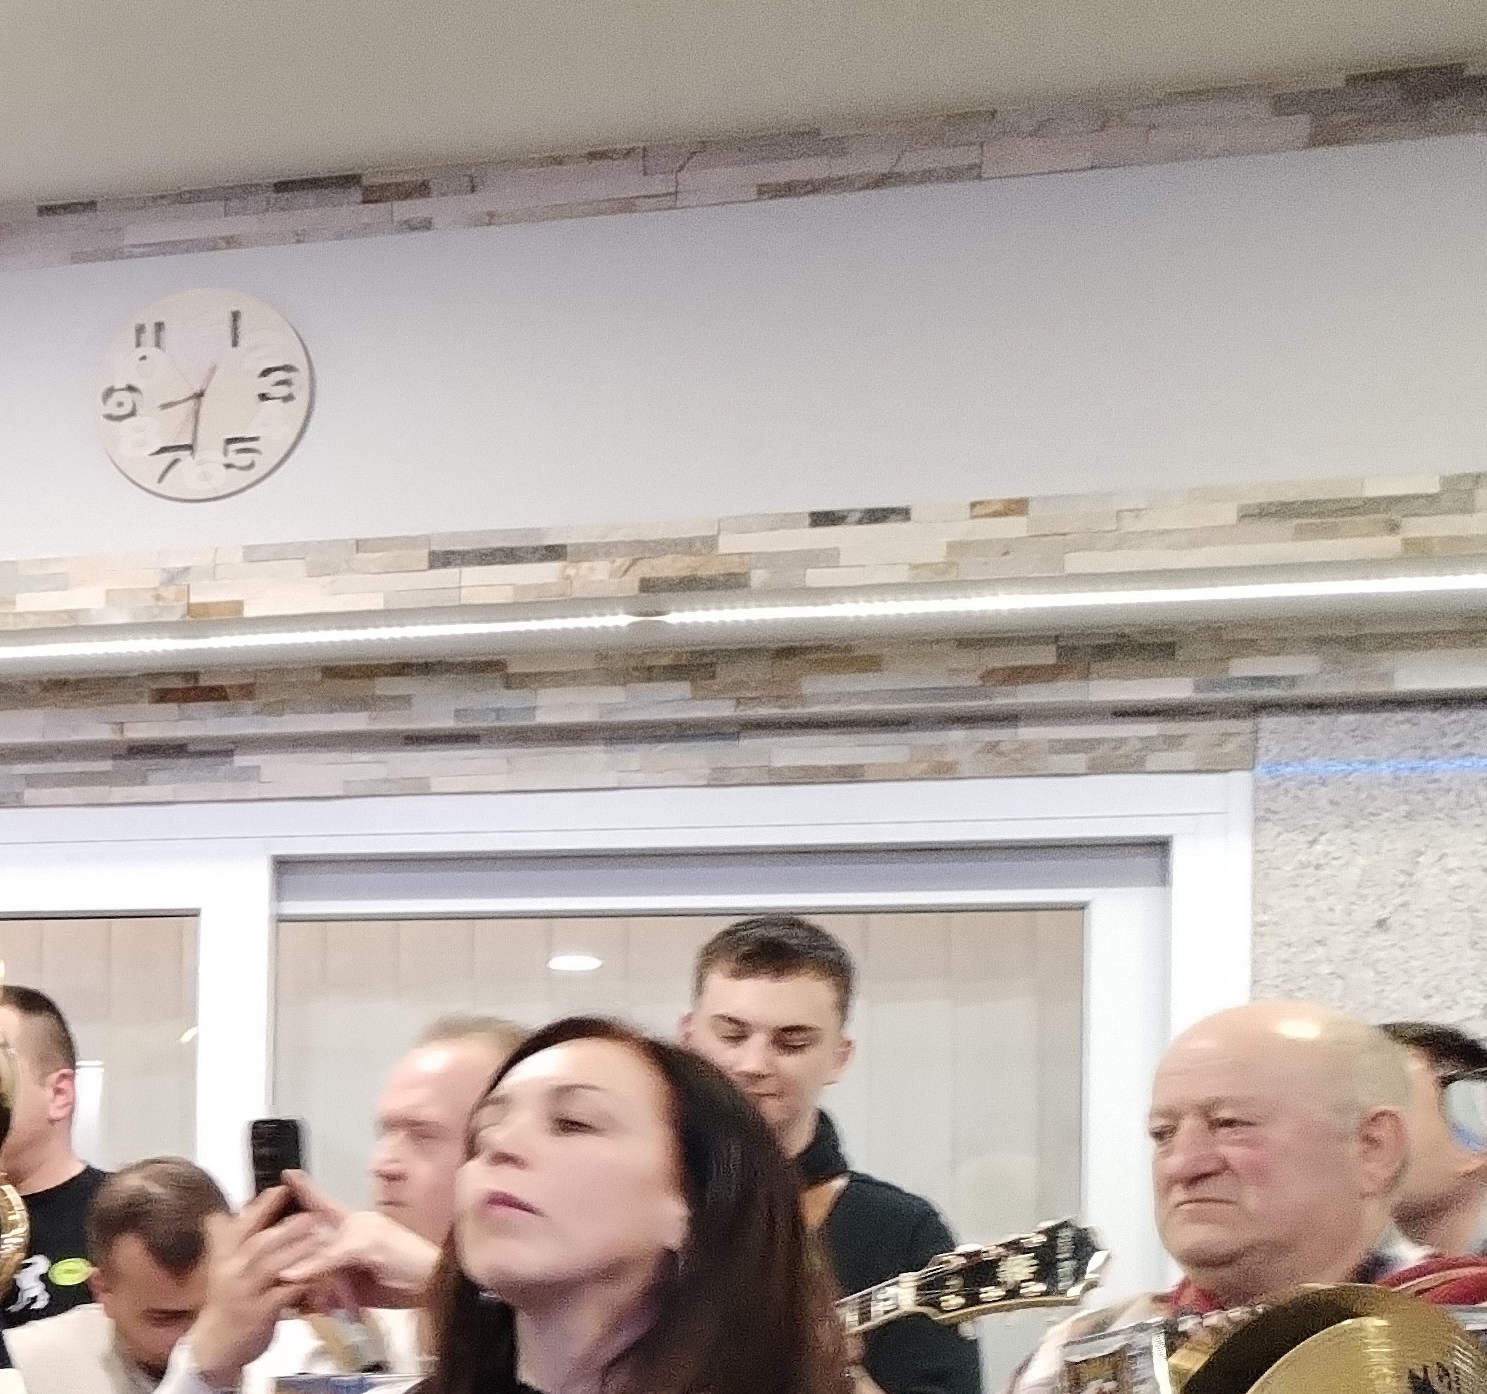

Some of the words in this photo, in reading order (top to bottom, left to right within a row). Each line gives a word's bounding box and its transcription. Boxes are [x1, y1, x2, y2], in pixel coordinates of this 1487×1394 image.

[100, 383, 143, 422] 9
[257, 363, 300, 403] 3
[148, 444, 195, 484] 7
[223, 435, 263, 471] 5
